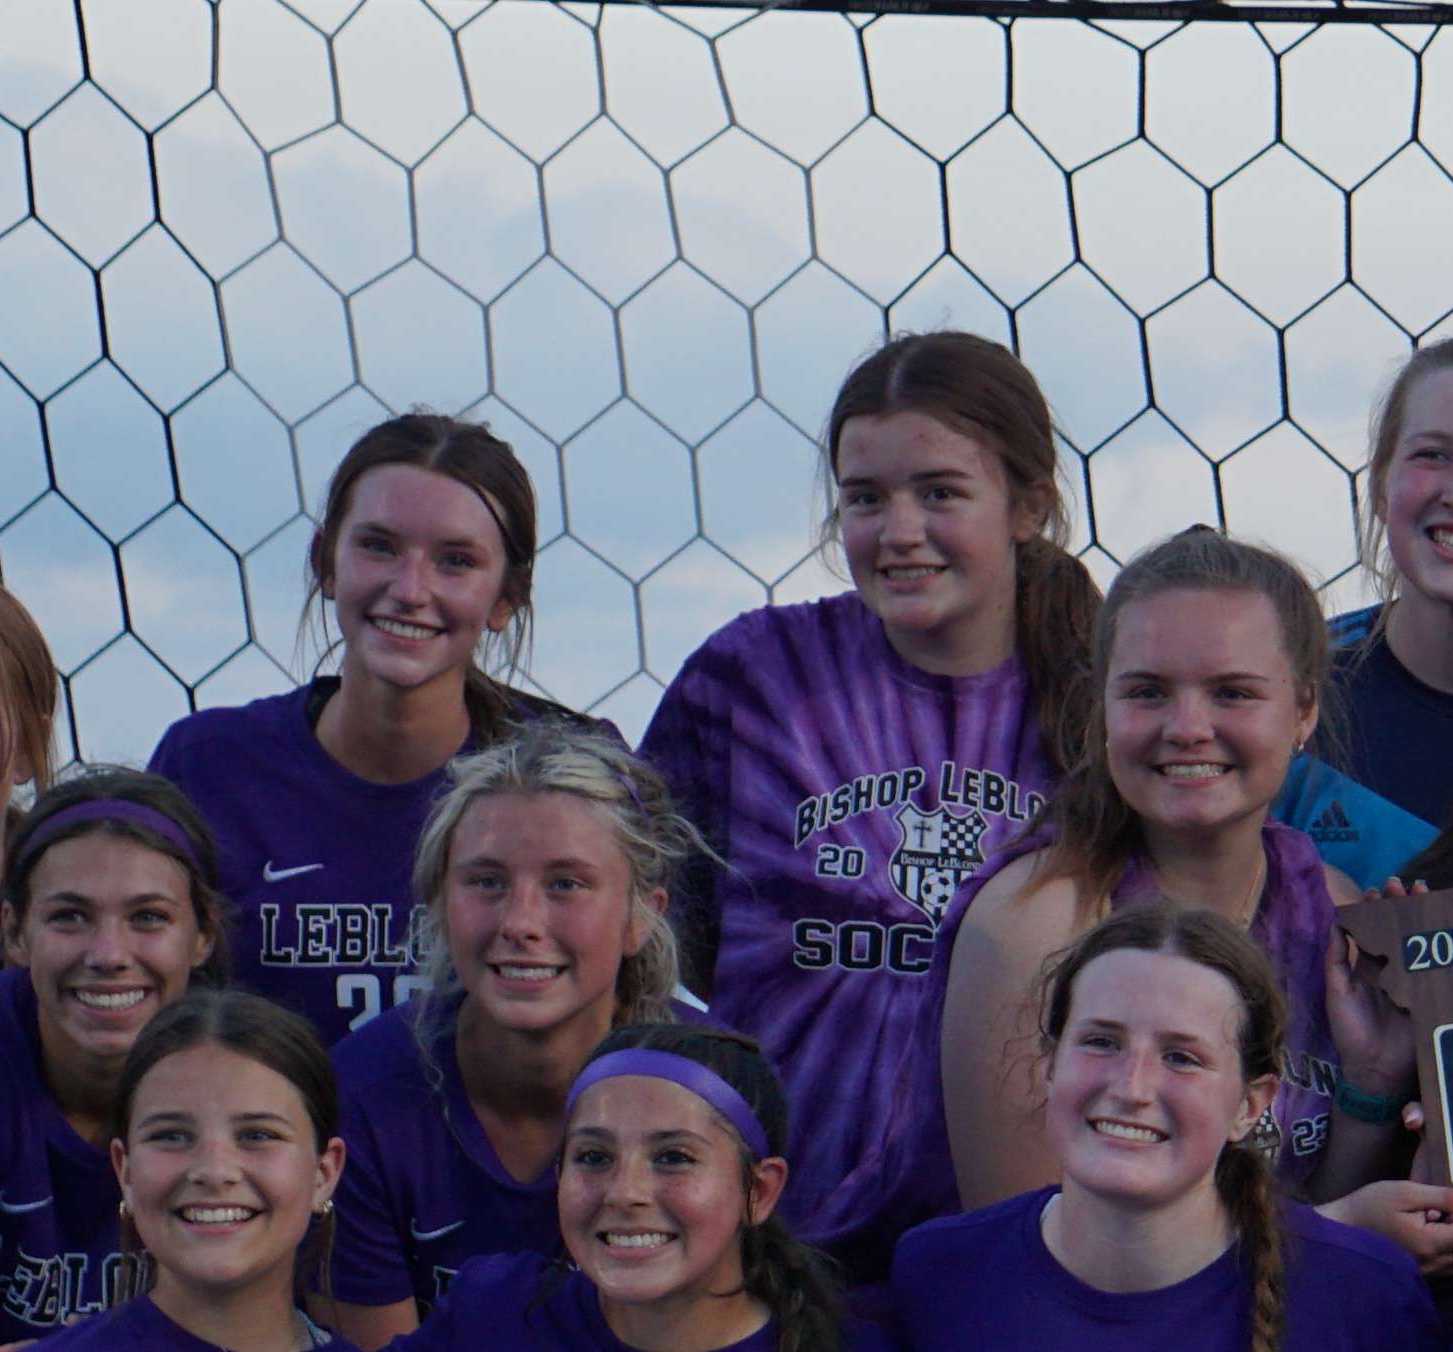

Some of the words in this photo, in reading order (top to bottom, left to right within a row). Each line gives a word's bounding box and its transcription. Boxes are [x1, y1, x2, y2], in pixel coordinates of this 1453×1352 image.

[795, 766, 926, 849] BISHOP
[815, 843, 867, 880] 20
[793, 918, 935, 976] SOC
